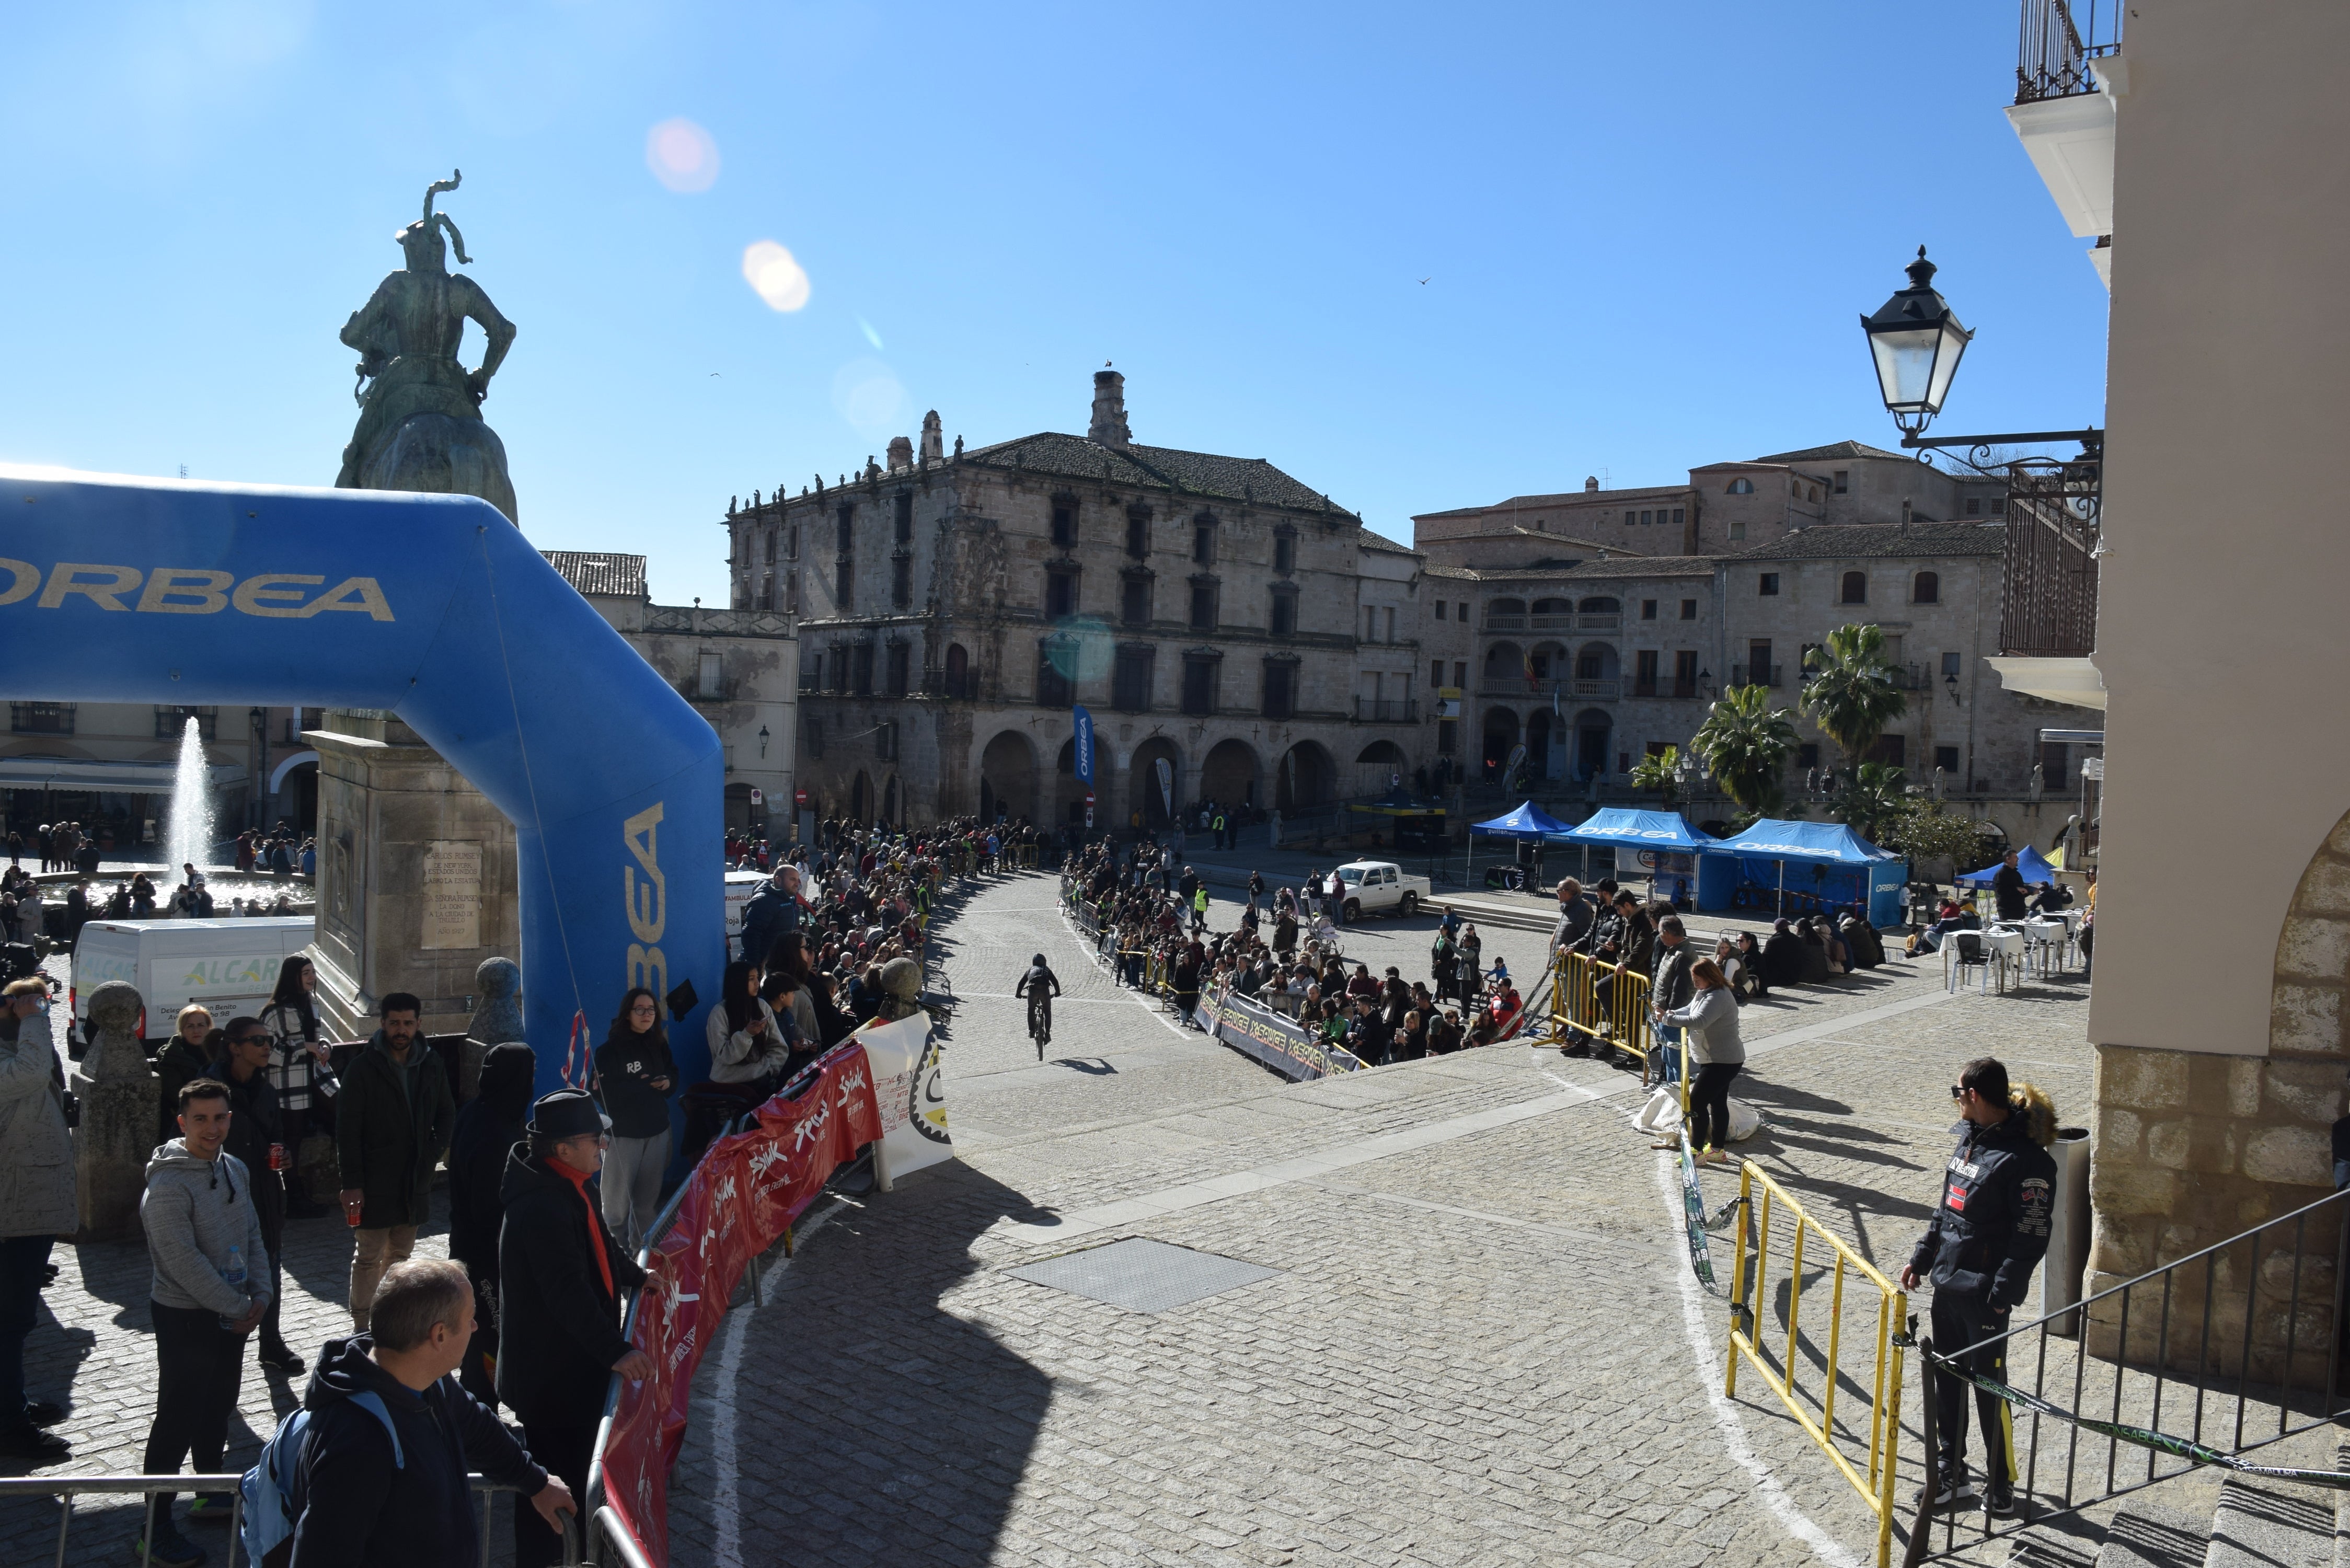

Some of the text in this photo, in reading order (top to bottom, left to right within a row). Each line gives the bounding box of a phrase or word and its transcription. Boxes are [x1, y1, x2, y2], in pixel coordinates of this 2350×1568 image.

[1079, 717, 1088, 776] ORBEA
[1576, 826, 1677, 839] ORBEA
[1735, 842, 1841, 857] ORBEA
[1875, 883, 1899, 892] ORBEA
[183, 958, 280, 986] ALCAR
[247, 984, 274, 993] RENT
[626, 1061, 642, 1074] RB
[896, 1090, 909, 1098] MTB
[898, 1112, 909, 1121] BIKE
[1976, 1374, 2002, 1394] DEPORTE
[2003, 1389, 2026, 1405] SOMOS
[2233, 1465, 2299, 1478] EXTREMADURA
